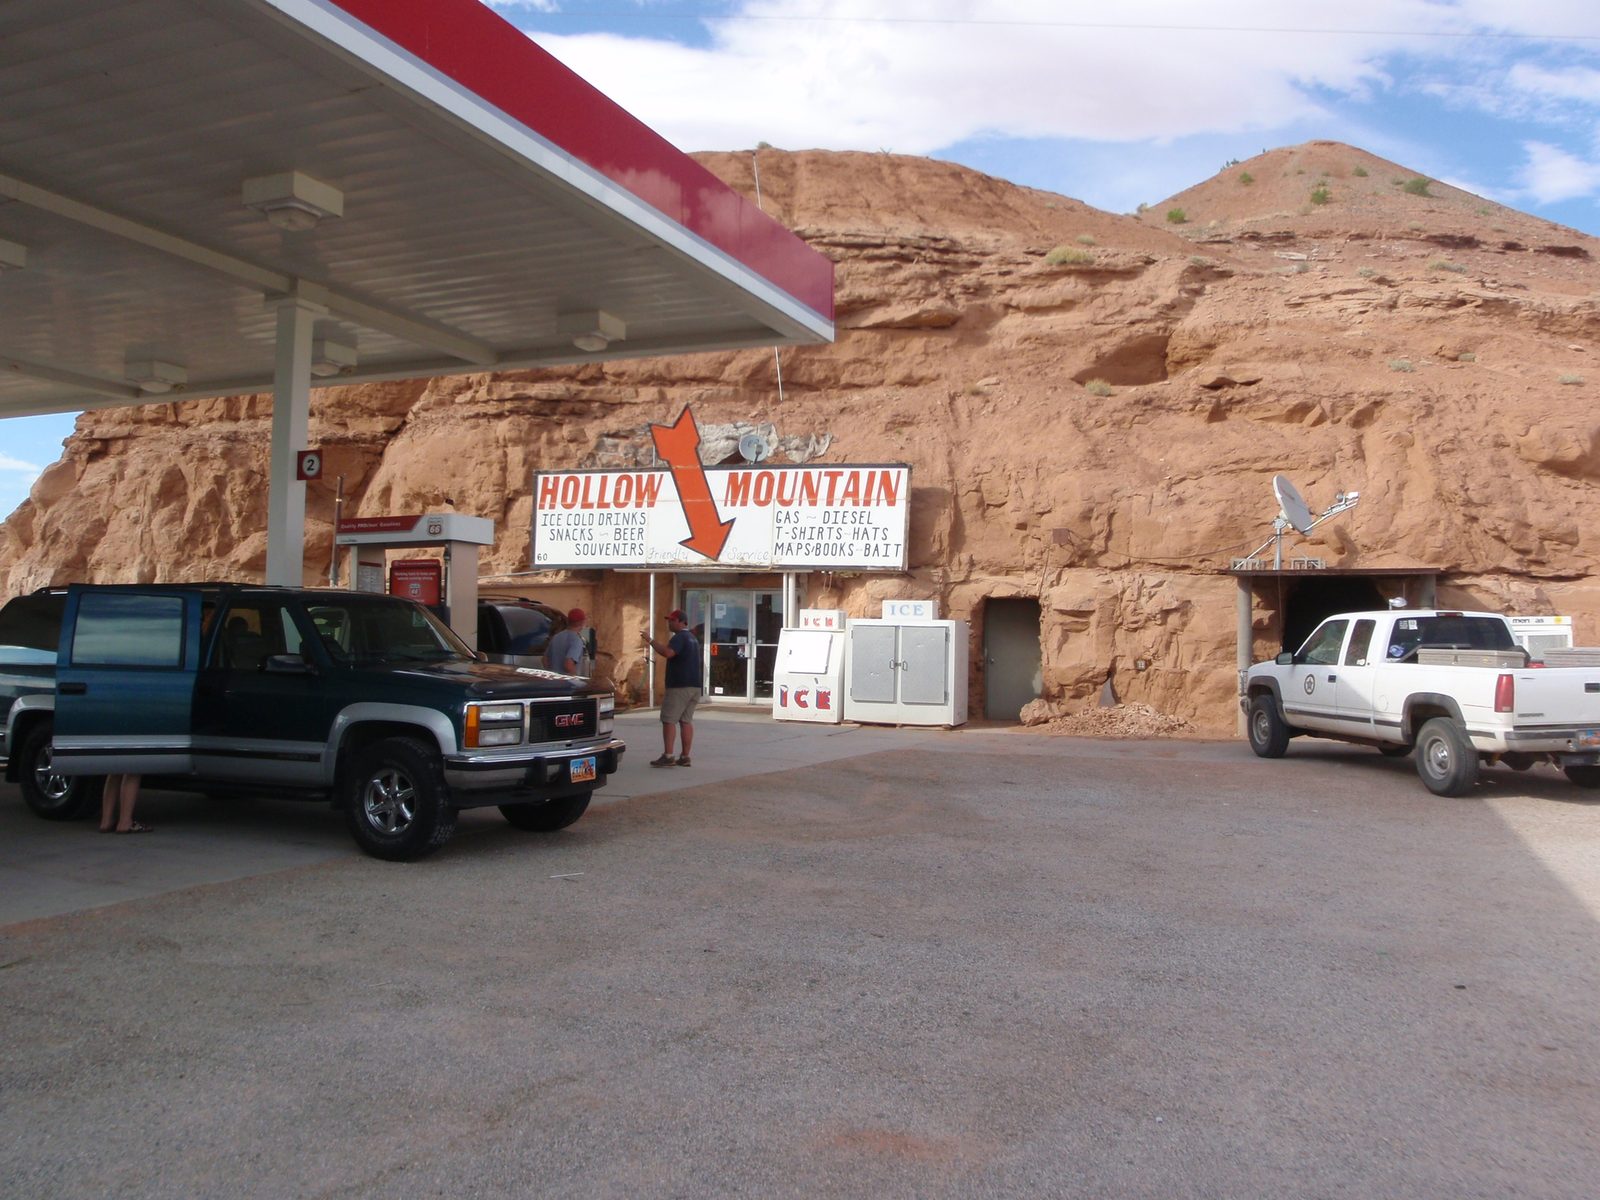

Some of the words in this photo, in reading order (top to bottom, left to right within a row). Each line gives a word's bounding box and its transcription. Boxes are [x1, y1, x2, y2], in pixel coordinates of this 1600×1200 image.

[307, 459, 315, 471] 2
[538, 473, 664, 510] HOLLOW
[724, 470, 901, 507] MOUNTAIN
[541, 513, 563, 527] ICE
[566, 513, 594, 526] COLD
[598, 512, 647, 526] DRINKS
[775, 510, 800, 524] GAS
[822, 510, 873, 525] DIESEL
[429, 525, 441, 534] 66
[549, 528, 594, 541] SNACKS
[613, 528, 644, 541] BEER
[775, 526, 843, 541] T-SHIRTS
[852, 527, 889, 541] HATS
[575, 543, 645, 556] SOUVENIRS
[727, 547, 769, 560] Service
[863, 543, 902, 557] BAIT
[537, 553, 548, 561] 60
[890, 604, 925, 616] ICE
[804, 616, 833, 627] ICE
[779, 684, 831, 710] ICE
[555, 712, 585, 727] GMC
